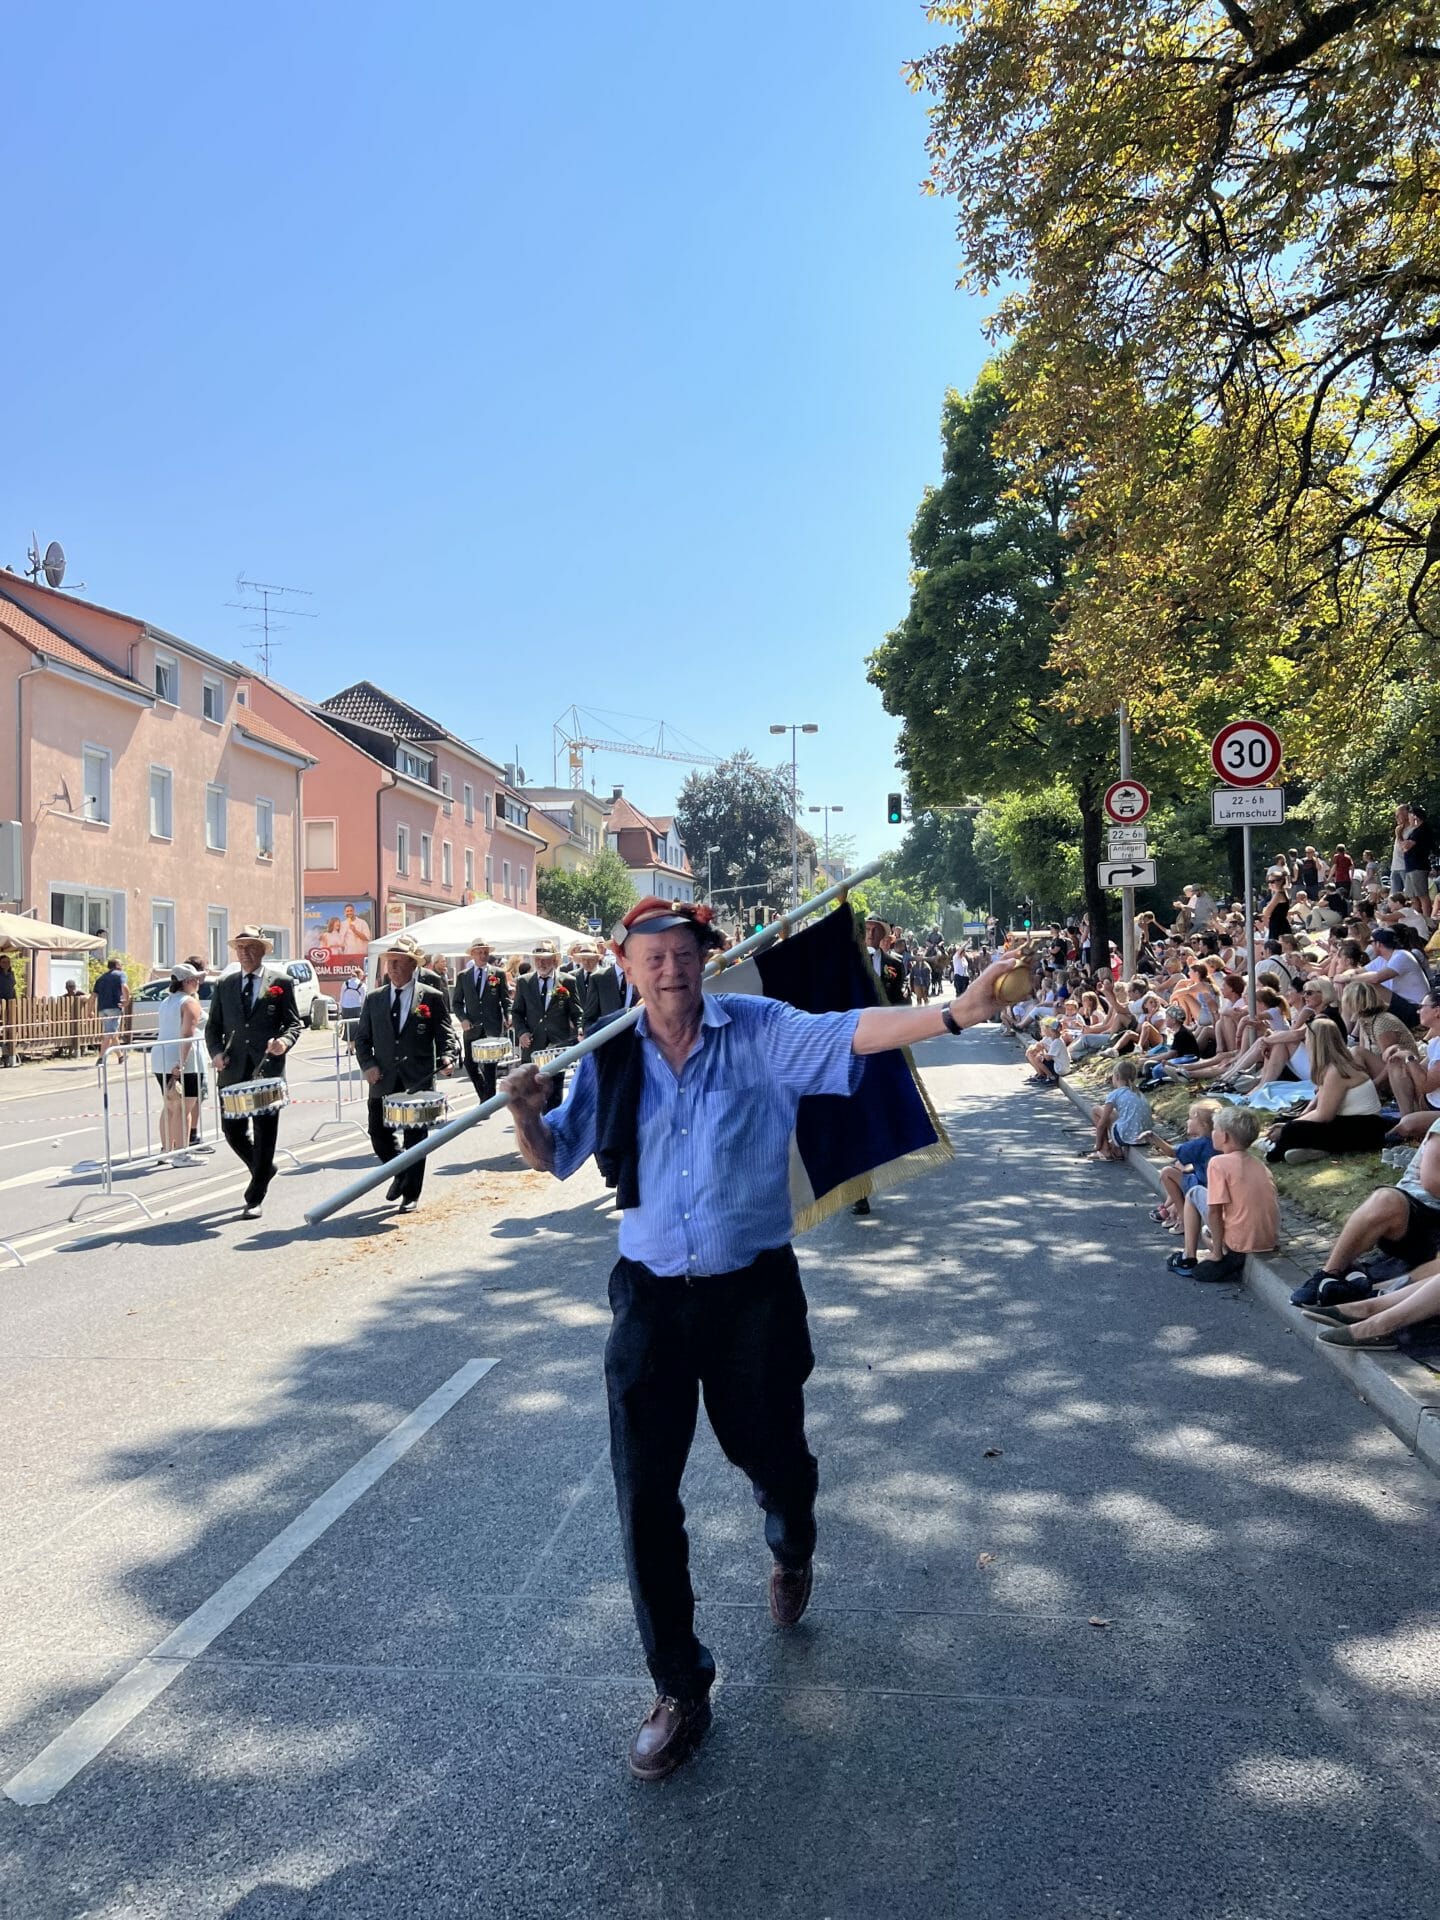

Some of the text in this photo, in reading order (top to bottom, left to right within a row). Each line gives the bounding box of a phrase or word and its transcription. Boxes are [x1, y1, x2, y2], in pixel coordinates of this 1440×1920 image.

[1227, 739, 1266, 768] 30
[1232, 796, 1244, 805] 22
[1219, 809, 1277, 819] Lärmschutz
